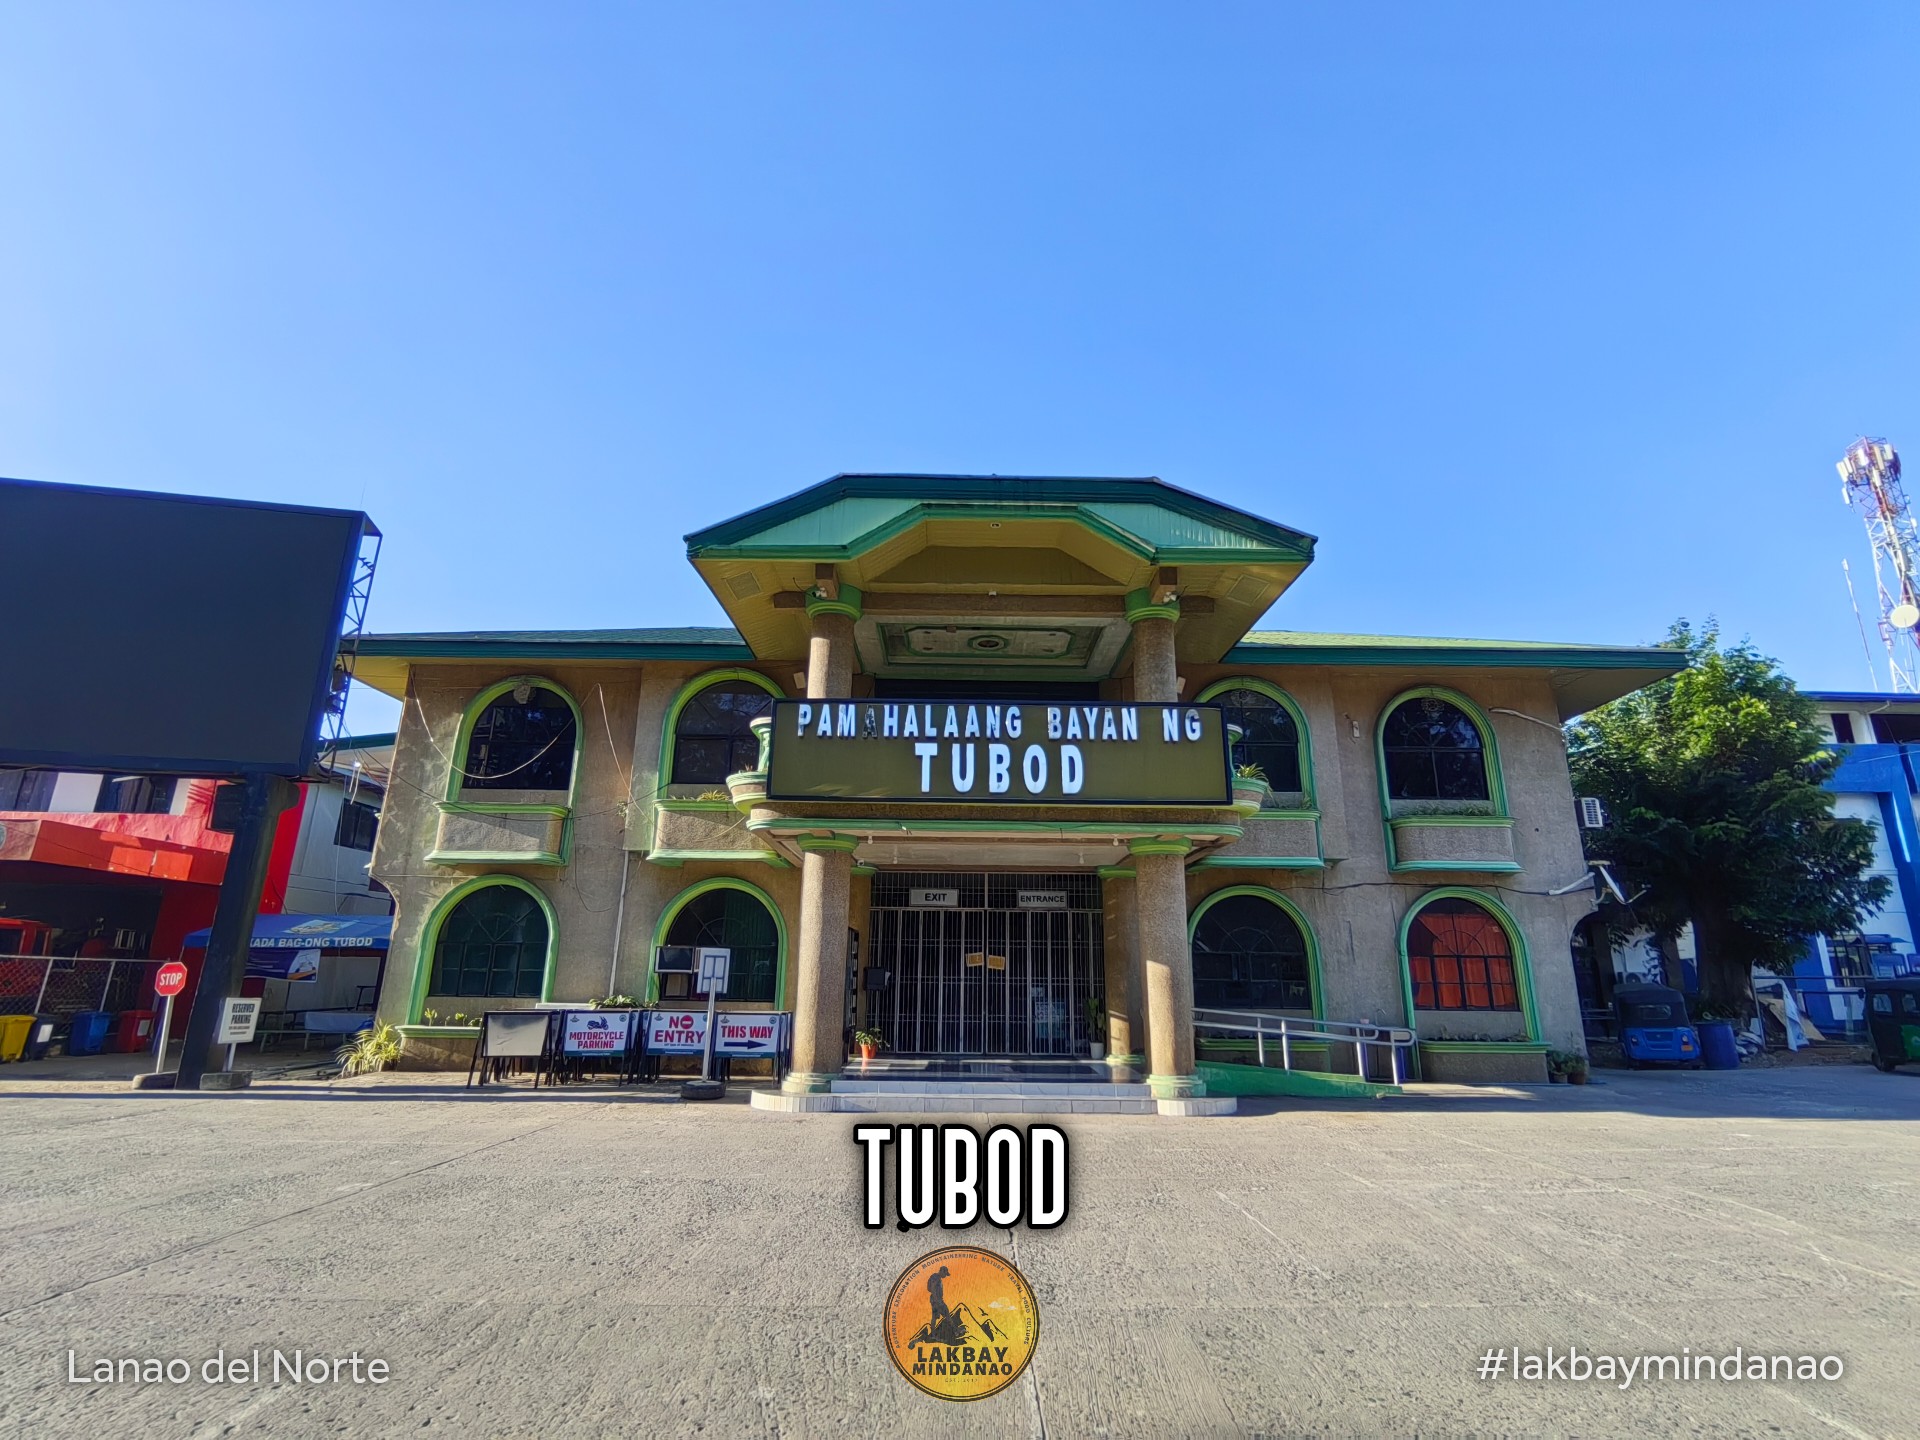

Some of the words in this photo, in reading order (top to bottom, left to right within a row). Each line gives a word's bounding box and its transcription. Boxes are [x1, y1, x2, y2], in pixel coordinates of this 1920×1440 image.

[797, 703, 1022, 740] PAMAHALAANG
[1047, 706, 1138, 741] BAYAN
[1162, 708, 1202, 742] NG
[914, 742, 1085, 794] TUBOD
[924, 892, 948, 902] EXIT
[1020, 894, 1065, 903] ENTRANCE
[279, 937, 330, 948] BAG-ONG
[334, 936, 373, 947] TUBOD
[160, 972, 183, 986] STOP
[569, 1031, 625, 1041] MOTORCYCLE
[654, 1030, 705, 1044] ENTRY
[721, 1025, 747, 1038] THIS
[749, 1026, 774, 1038] WAY
[577, 1040, 615, 1049] PARKING
